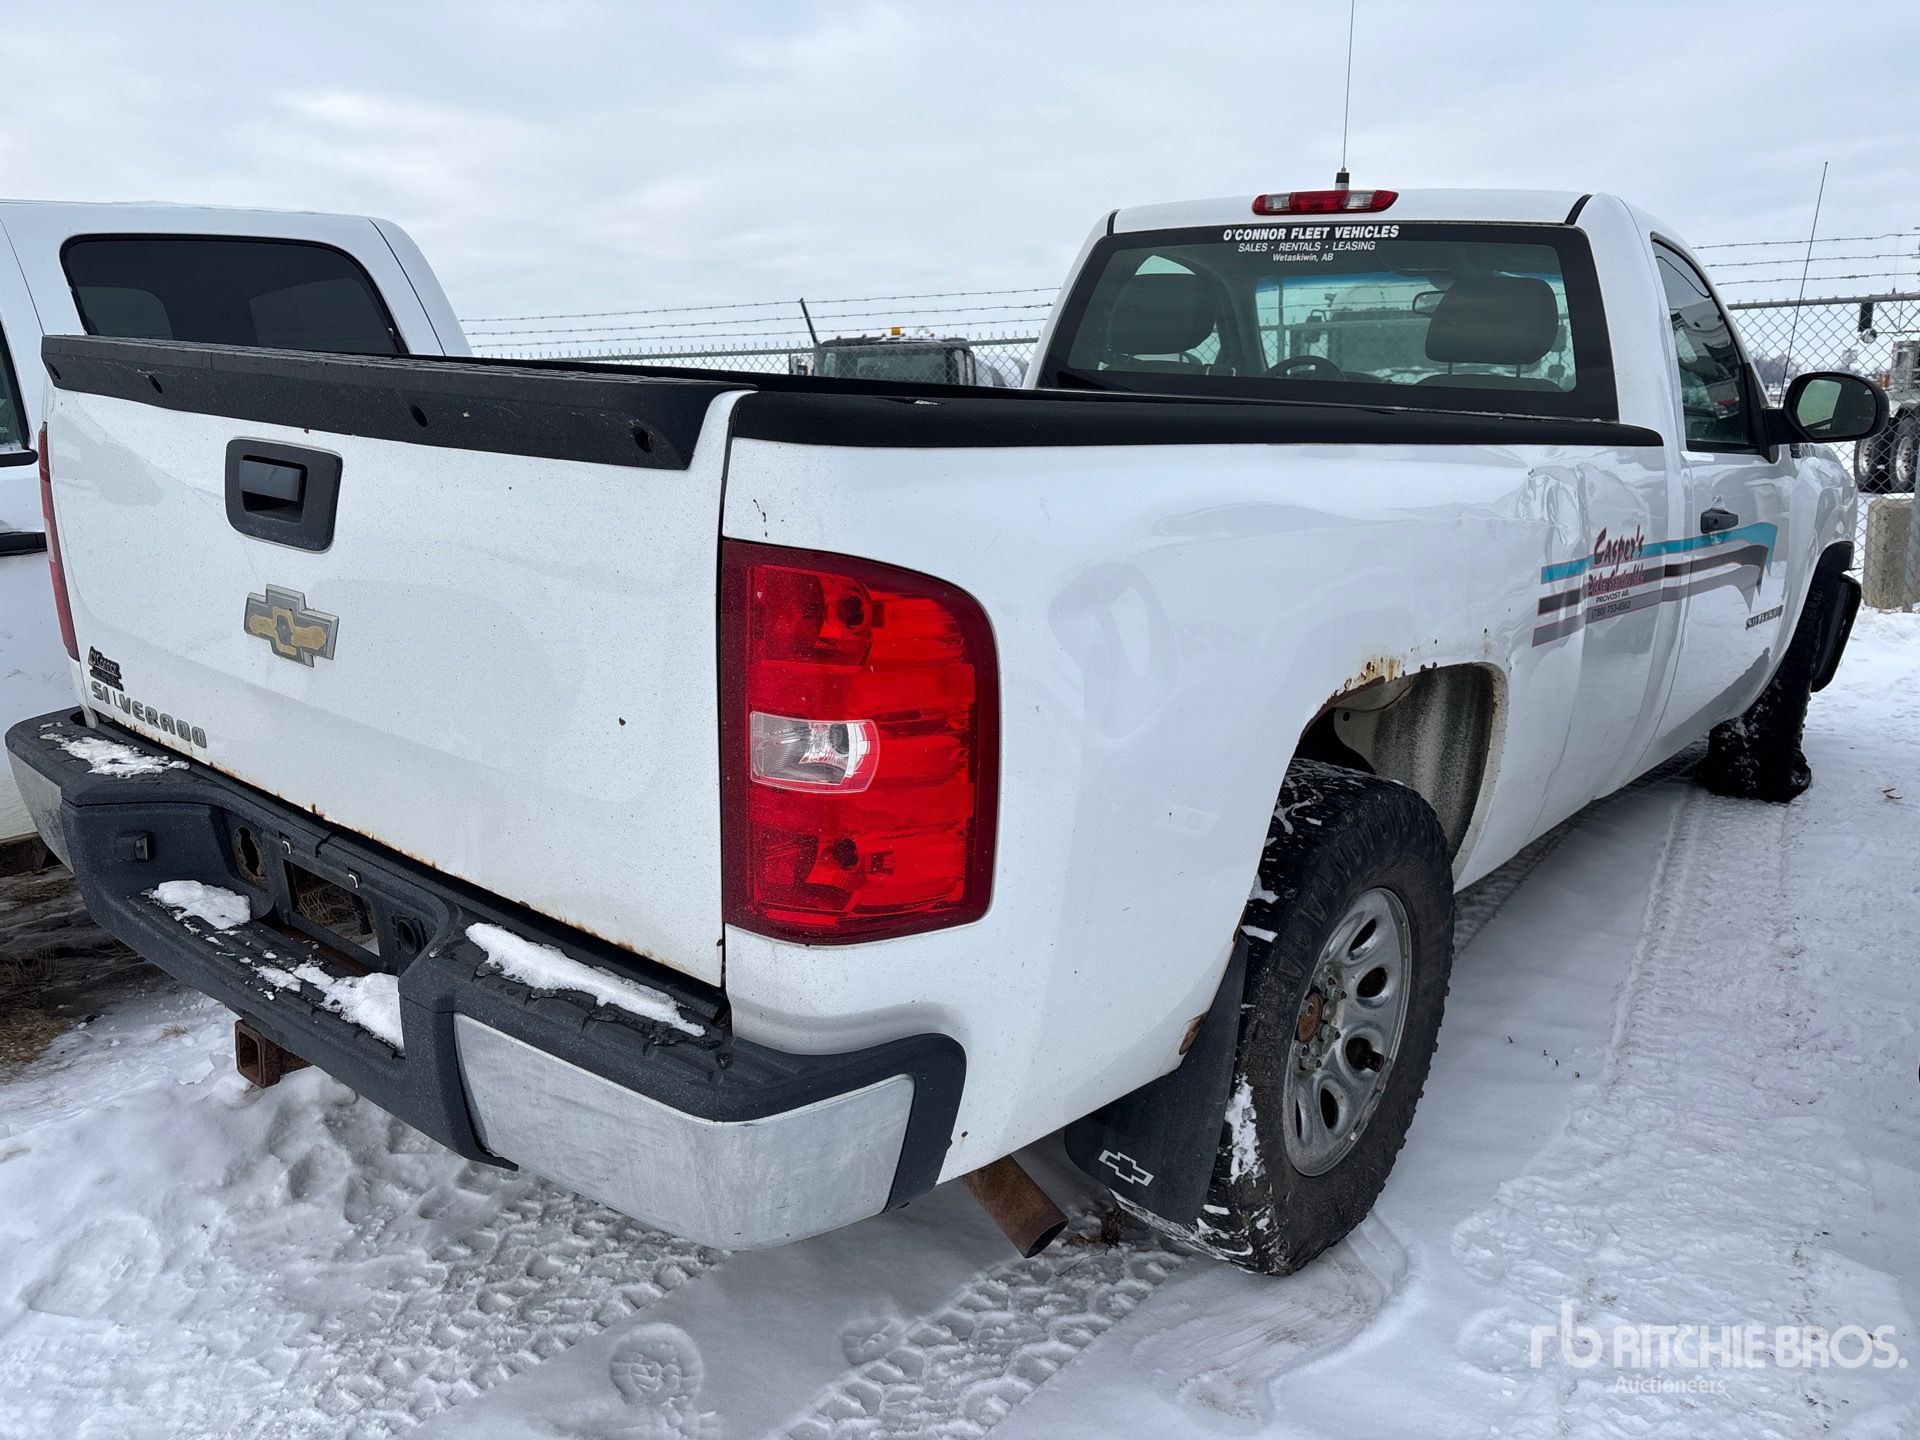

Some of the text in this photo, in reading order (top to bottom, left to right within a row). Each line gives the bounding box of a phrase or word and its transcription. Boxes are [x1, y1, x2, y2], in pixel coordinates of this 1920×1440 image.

[1223, 225, 1400, 241] O'CONNOR FLEET VEHICLES
[1238, 241, 1376, 252] SALES RENTALS LEASING
[1272, 253, 1334, 262] Wetaskiwin, AB
[1594, 524, 1645, 574] Casper's
[1595, 591, 1620, 604] PROVOST
